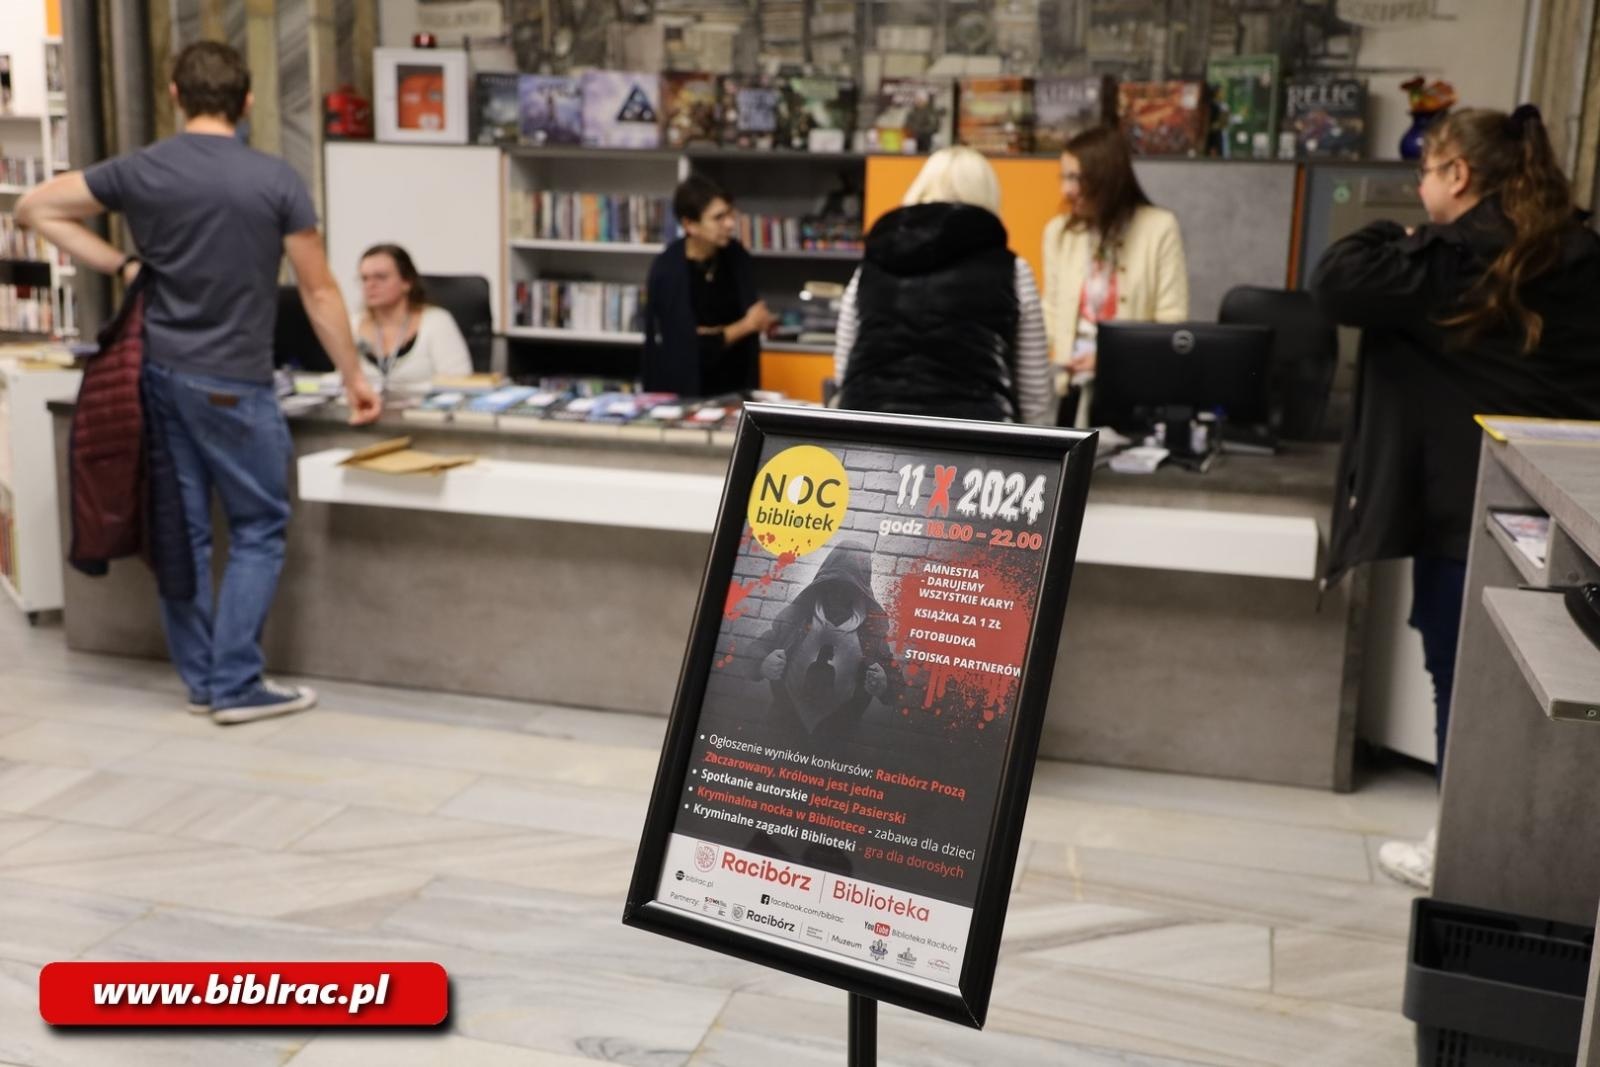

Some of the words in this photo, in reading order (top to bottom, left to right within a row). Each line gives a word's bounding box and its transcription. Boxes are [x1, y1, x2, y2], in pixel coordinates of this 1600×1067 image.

[760, 472, 841, 508] NOC
[897, 464, 926, 510] 11
[926, 464, 957, 517] X
[956, 468, 1047, 525] 2024
[756, 506, 834, 532] bibliotek
[879, 519, 923, 536] godz
[925, 520, 974, 542] 18.00
[989, 528, 1043, 550] 22.00
[923, 563, 979, 579] AMNESTIA
[927, 576, 984, 593] DARUJEMY
[919, 588, 978, 605] WSZYSTKIE
[980, 596, 1014, 610] KARY!
[914, 607, 959, 623] KSIĄŻKA
[962, 615, 977, 626] ZA
[979, 617, 985, 627] 1
[988, 619, 1002, 630] ZŁ
[909, 628, 976, 648] FOTOBUDKA
[904, 649, 951, 665] STOISKA
[704, 751, 776, 778] Zaczarowany,
[779, 767, 825, 788] Królowa
[825, 776, 850, 792] jest
[848, 781, 885, 800] jedna
[709, 734, 763, 755] Ogłoszenie
[764, 748, 809, 765] wyników
[811, 755, 874, 779] konkursów:
[876, 769, 929, 791] Racibórz
[930, 780, 967, 801] Prozą
[701, 768, 754, 790] Spotkanie
[755, 782, 809, 802] autorskie
[808, 793, 850, 815] Jędrzej
[851, 802, 908, 825] Pasierski
[697, 785, 758, 810] Kryminalna
[759, 801, 794, 818] nocka
[795, 811, 807, 821] w
[808, 811, 866, 834] Bibliotece
[874, 828, 919, 847] zabawa
[920, 838, 940, 853] dla
[941, 842, 977, 862] dzieci
[693, 802, 755, 828] Kryminalne
[756, 818, 800, 839] zagadki
[800, 829, 857, 853] Biblioteki
[864, 846, 884, 860] gra
[886, 849, 905, 865] dla
[906, 856, 965, 880] dorosłych
[721, 851, 813, 892] Racibórz
[832, 879, 931, 922] Biblioteka
[746, 909, 796, 933] Racibórz
[831, 934, 863, 950] Muzeum
